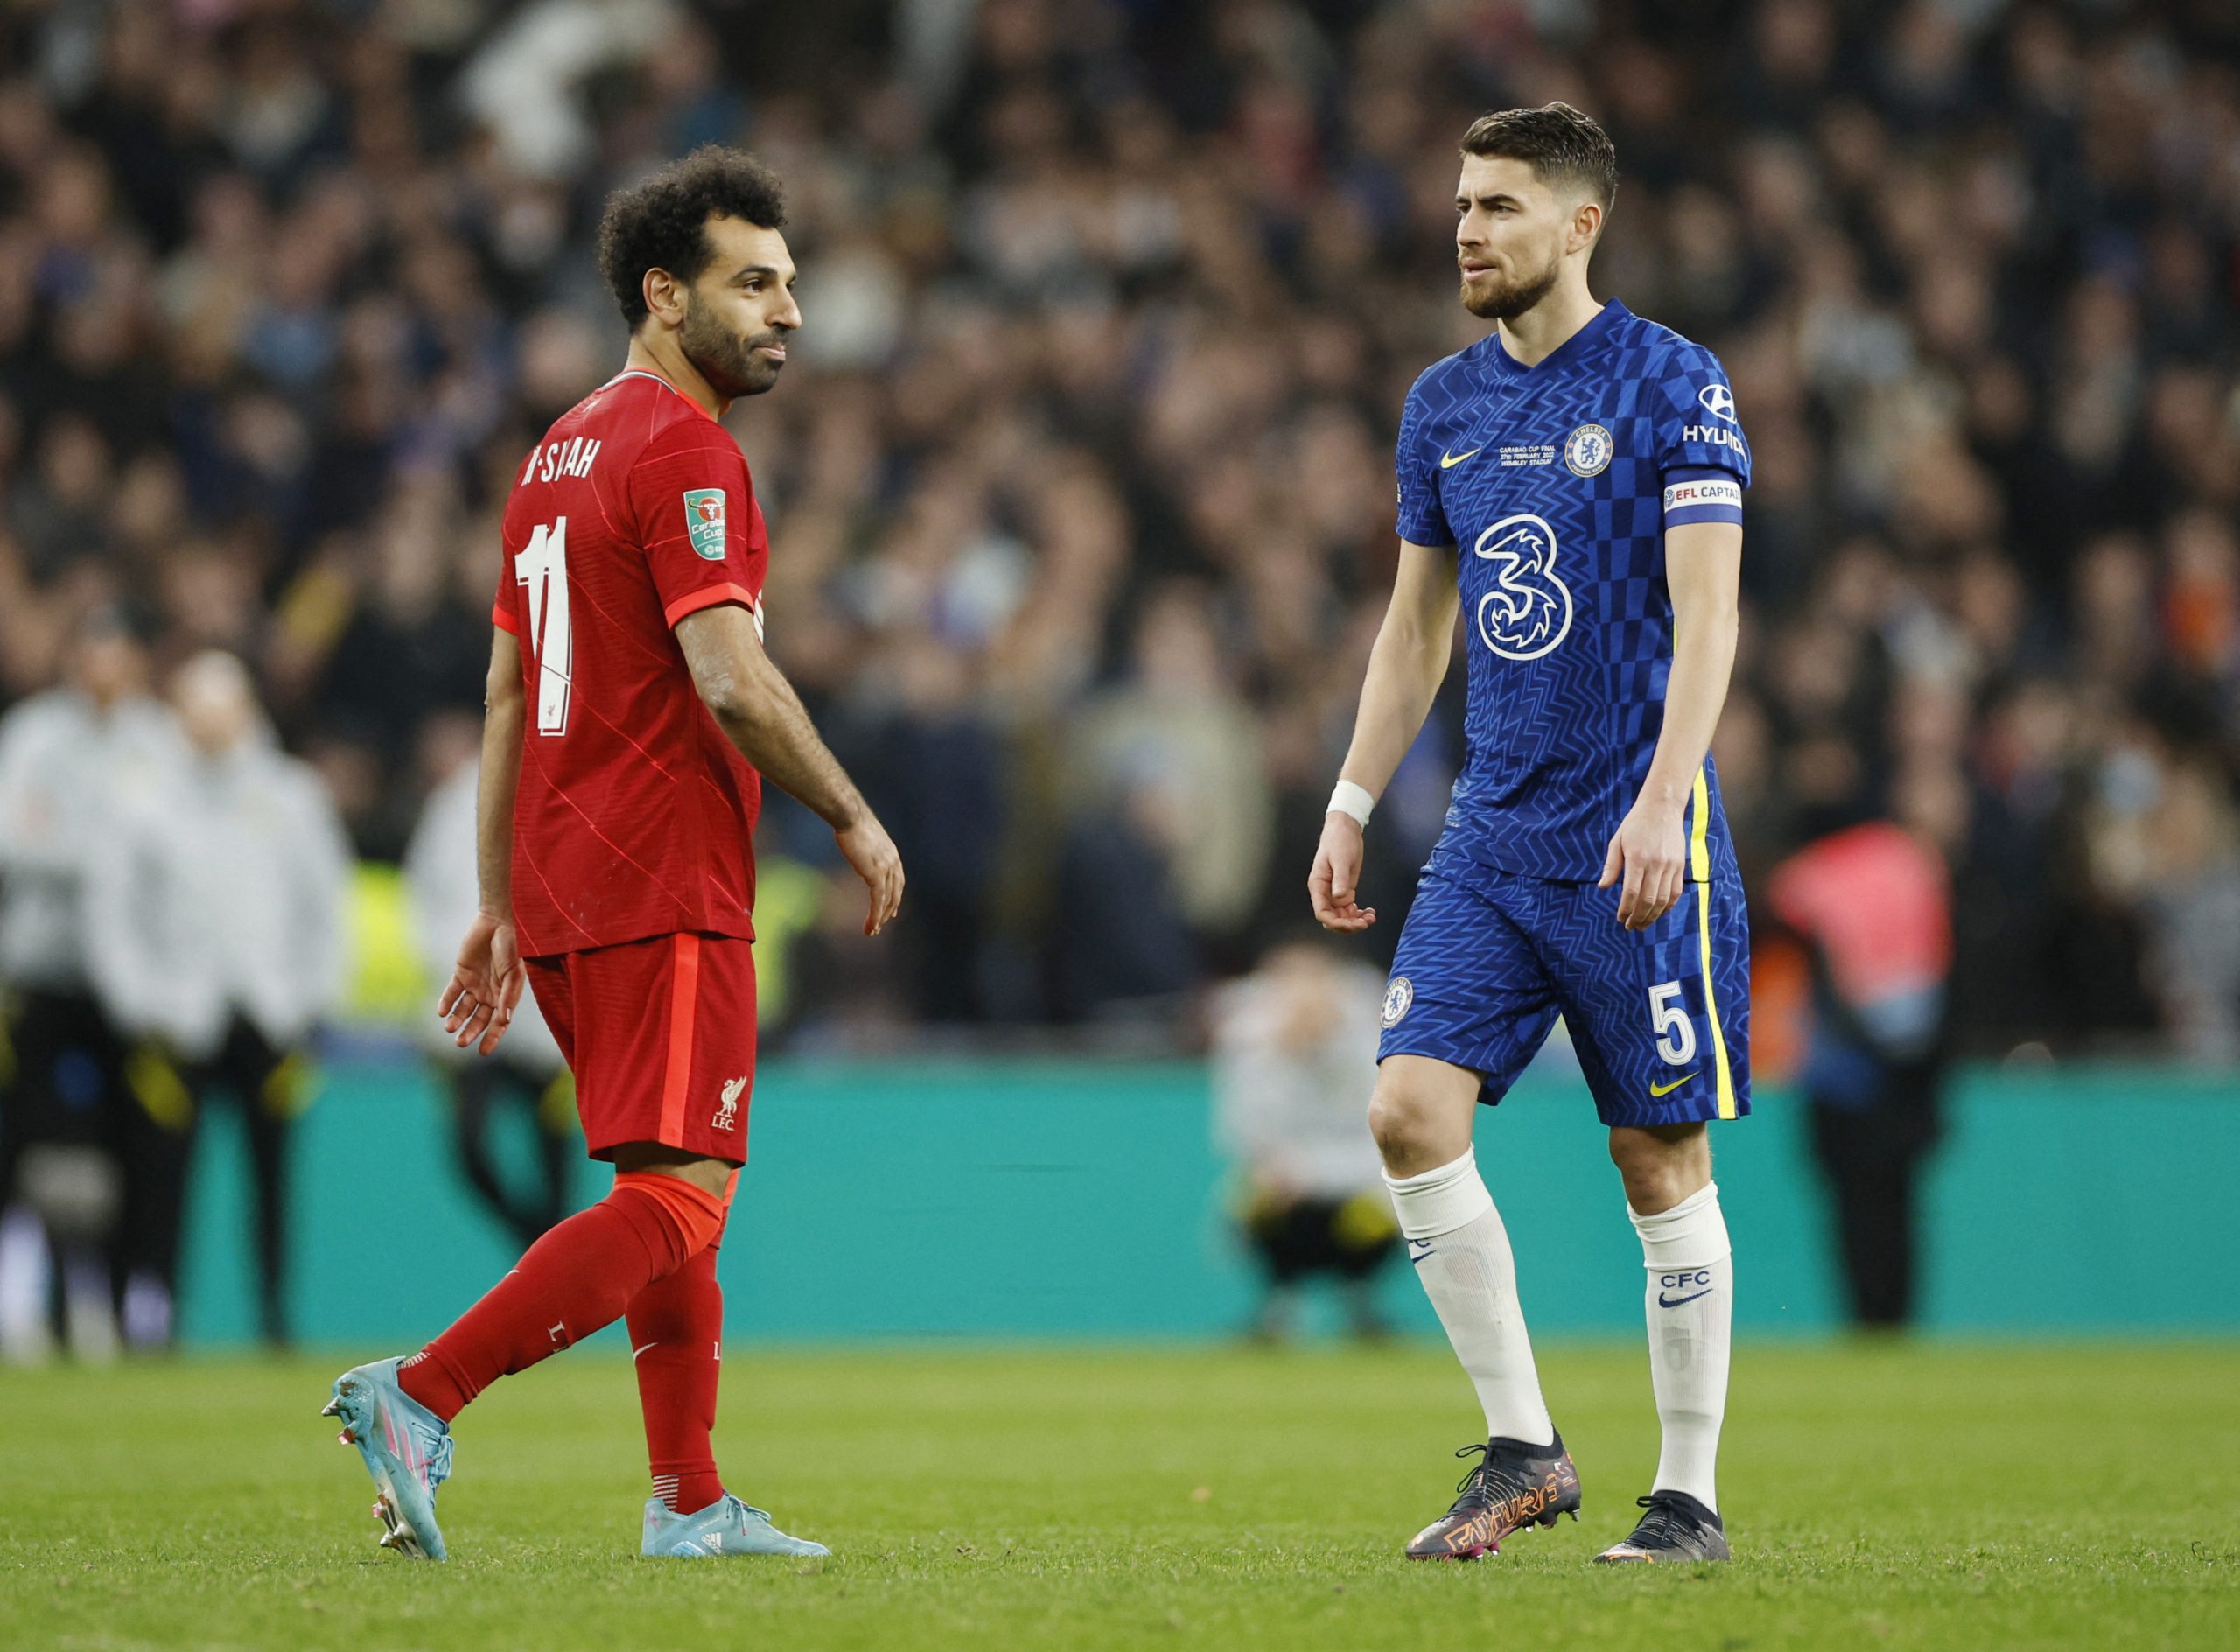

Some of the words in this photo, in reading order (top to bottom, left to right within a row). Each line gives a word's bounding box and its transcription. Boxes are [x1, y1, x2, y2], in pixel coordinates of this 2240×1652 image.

[1575, 426, 1606, 438] CHELSEA
[1676, 488, 1698, 500] EFL
[704, 528, 723, 540] Cup
[514, 516, 572, 737] 11
[1648, 980, 1697, 1066] 5
[1661, 1270, 1710, 1288] CFC
